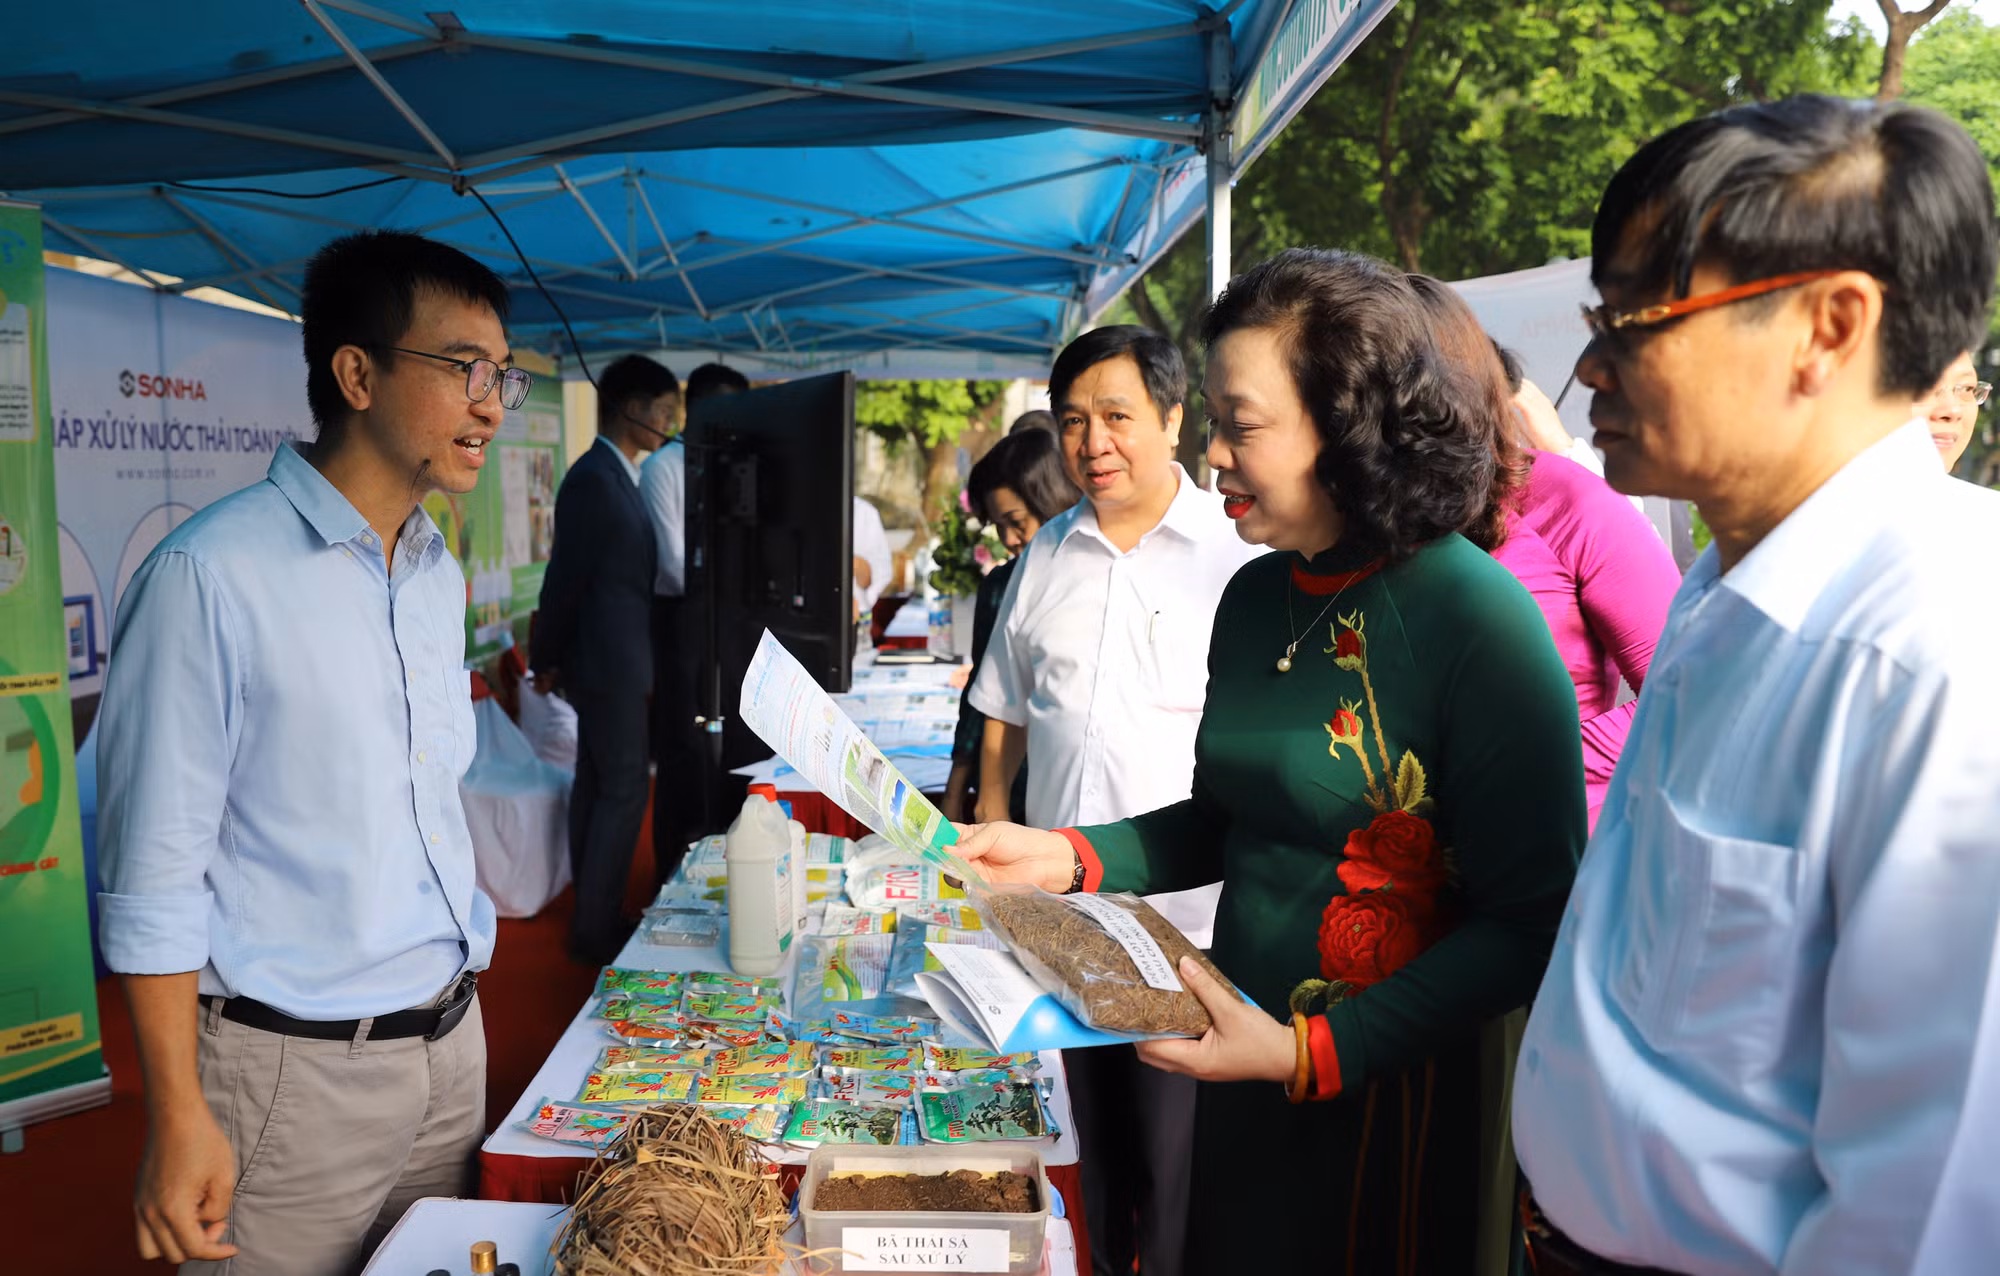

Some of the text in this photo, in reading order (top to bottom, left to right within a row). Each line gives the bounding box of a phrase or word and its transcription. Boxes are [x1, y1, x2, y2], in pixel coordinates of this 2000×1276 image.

[137, 373, 207, 401] SONHA
[87, 409, 118, 450] XỬ
[120, 414, 138, 450] LÝ
[141, 416, 194, 451] NƯỚC
[197, 417, 233, 452] THẢI
[801, 1120, 817, 1137] FITO
[949, 1117, 966, 1138] FITO
[877, 1233, 898, 1249] BÃ
[879, 1252, 911, 1265] SAU
[944, 1251, 967, 1265] LÝ
